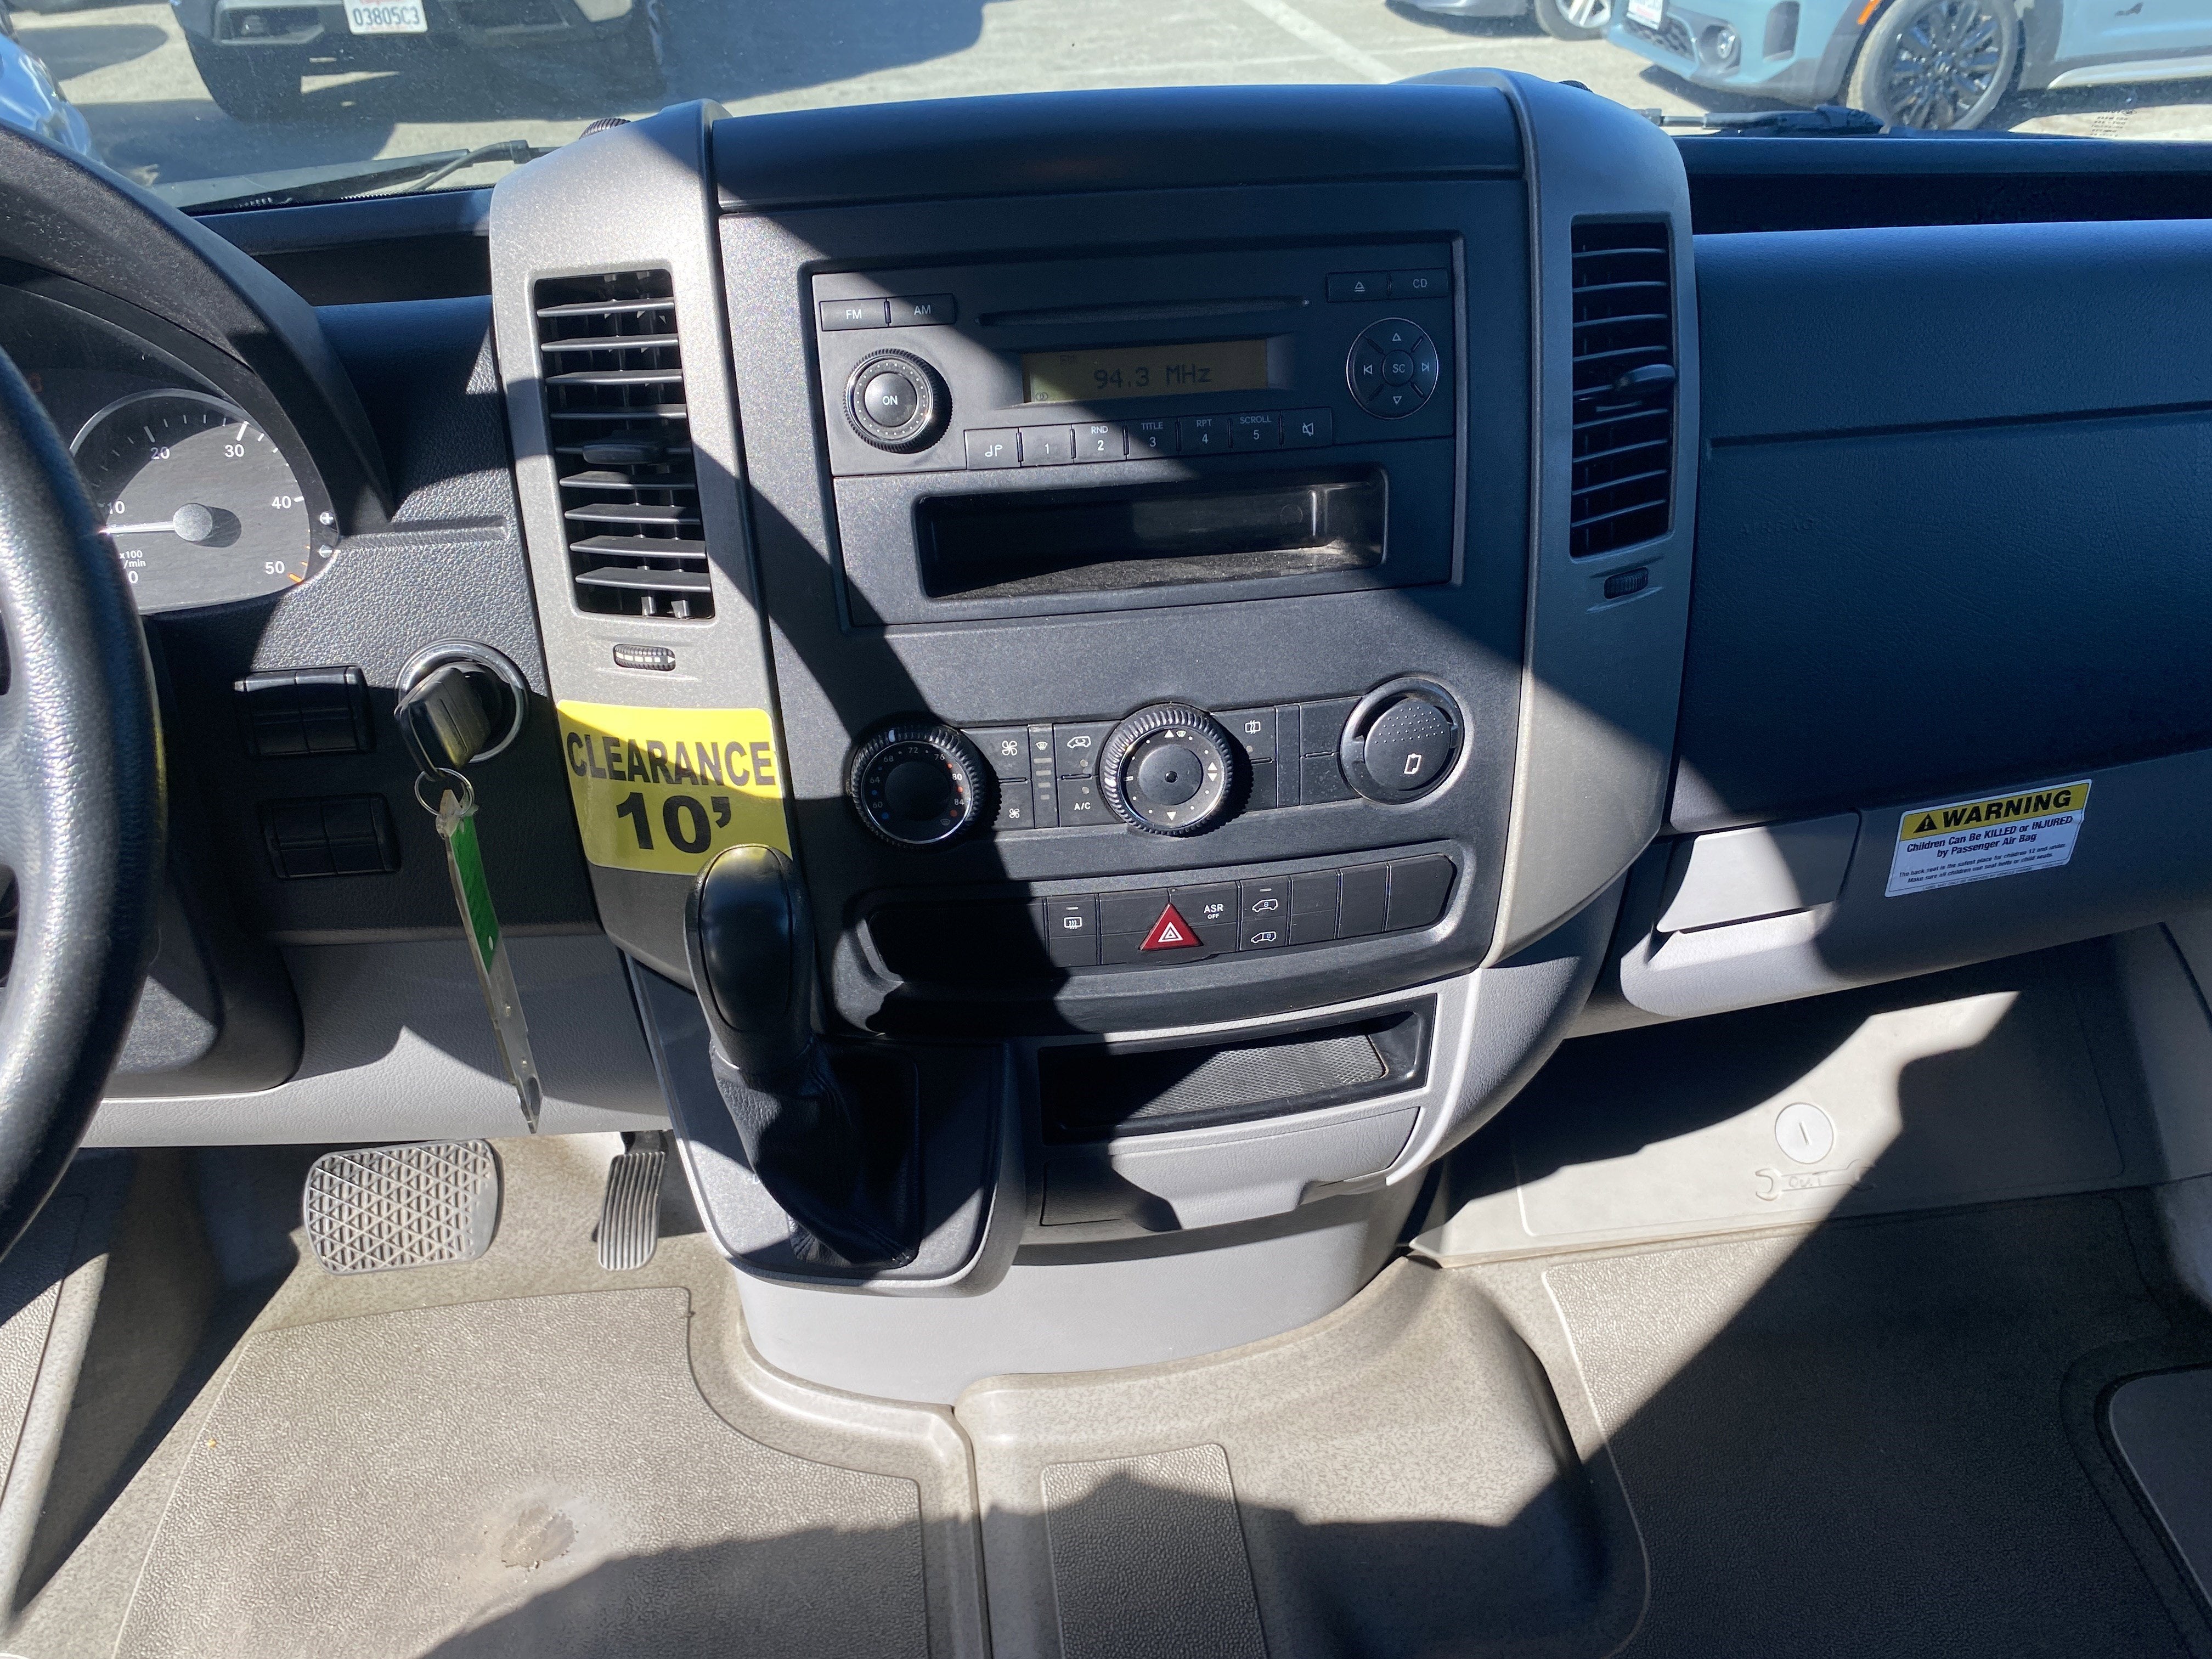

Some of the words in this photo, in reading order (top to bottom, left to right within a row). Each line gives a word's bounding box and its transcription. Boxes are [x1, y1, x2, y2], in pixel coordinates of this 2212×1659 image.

[353, 7, 420, 26] 03805C3
[1413, 278, 1427, 289] CD
[845, 309, 862, 320] FM
[913, 304, 932, 315] AM
[1392, 363, 1406, 374] SC
[1094, 366, 1150, 389] 94.3
[1166, 363, 1212, 385] MHz
[882, 395, 898, 405] ON
[1196, 418, 1212, 428] RPT
[1239, 415, 1272, 425] SCROLL
[1091, 425, 1109, 434] RND
[1141, 421, 1164, 431] TITLE
[1201, 434, 1209, 444] 4
[1253, 430, 1260, 440] 5
[1097, 439, 1104, 451] 2
[1149, 437, 1156, 447] 3
[150, 447, 170, 460] 20
[224, 444, 245, 458] 30
[1045, 443, 1049, 454] 1
[271, 495, 292, 510] 40
[119, 550, 143, 558] x100
[264, 560, 285, 574] 50
[128, 570, 138, 584] 0
[566, 731, 777, 787] CLEARANCE
[1074, 802, 1091, 811] A/C
[1942, 789, 2072, 828] WARNING
[1906, 839, 1946, 853] Children
[1948, 836, 1966, 845] Can
[1968, 833, 1982, 842] Be
[1984, 826, 2017, 839] KILLED
[2019, 825, 2030, 833] or
[2032, 815, 2073, 830] INJURED
[1937, 849, 1949, 859] by
[1951, 841, 2000, 855] Passenger
[2001, 836, 2017, 846] Air
[2018, 833, 2038, 843] Bag
[1204, 903, 1224, 913] ASR
